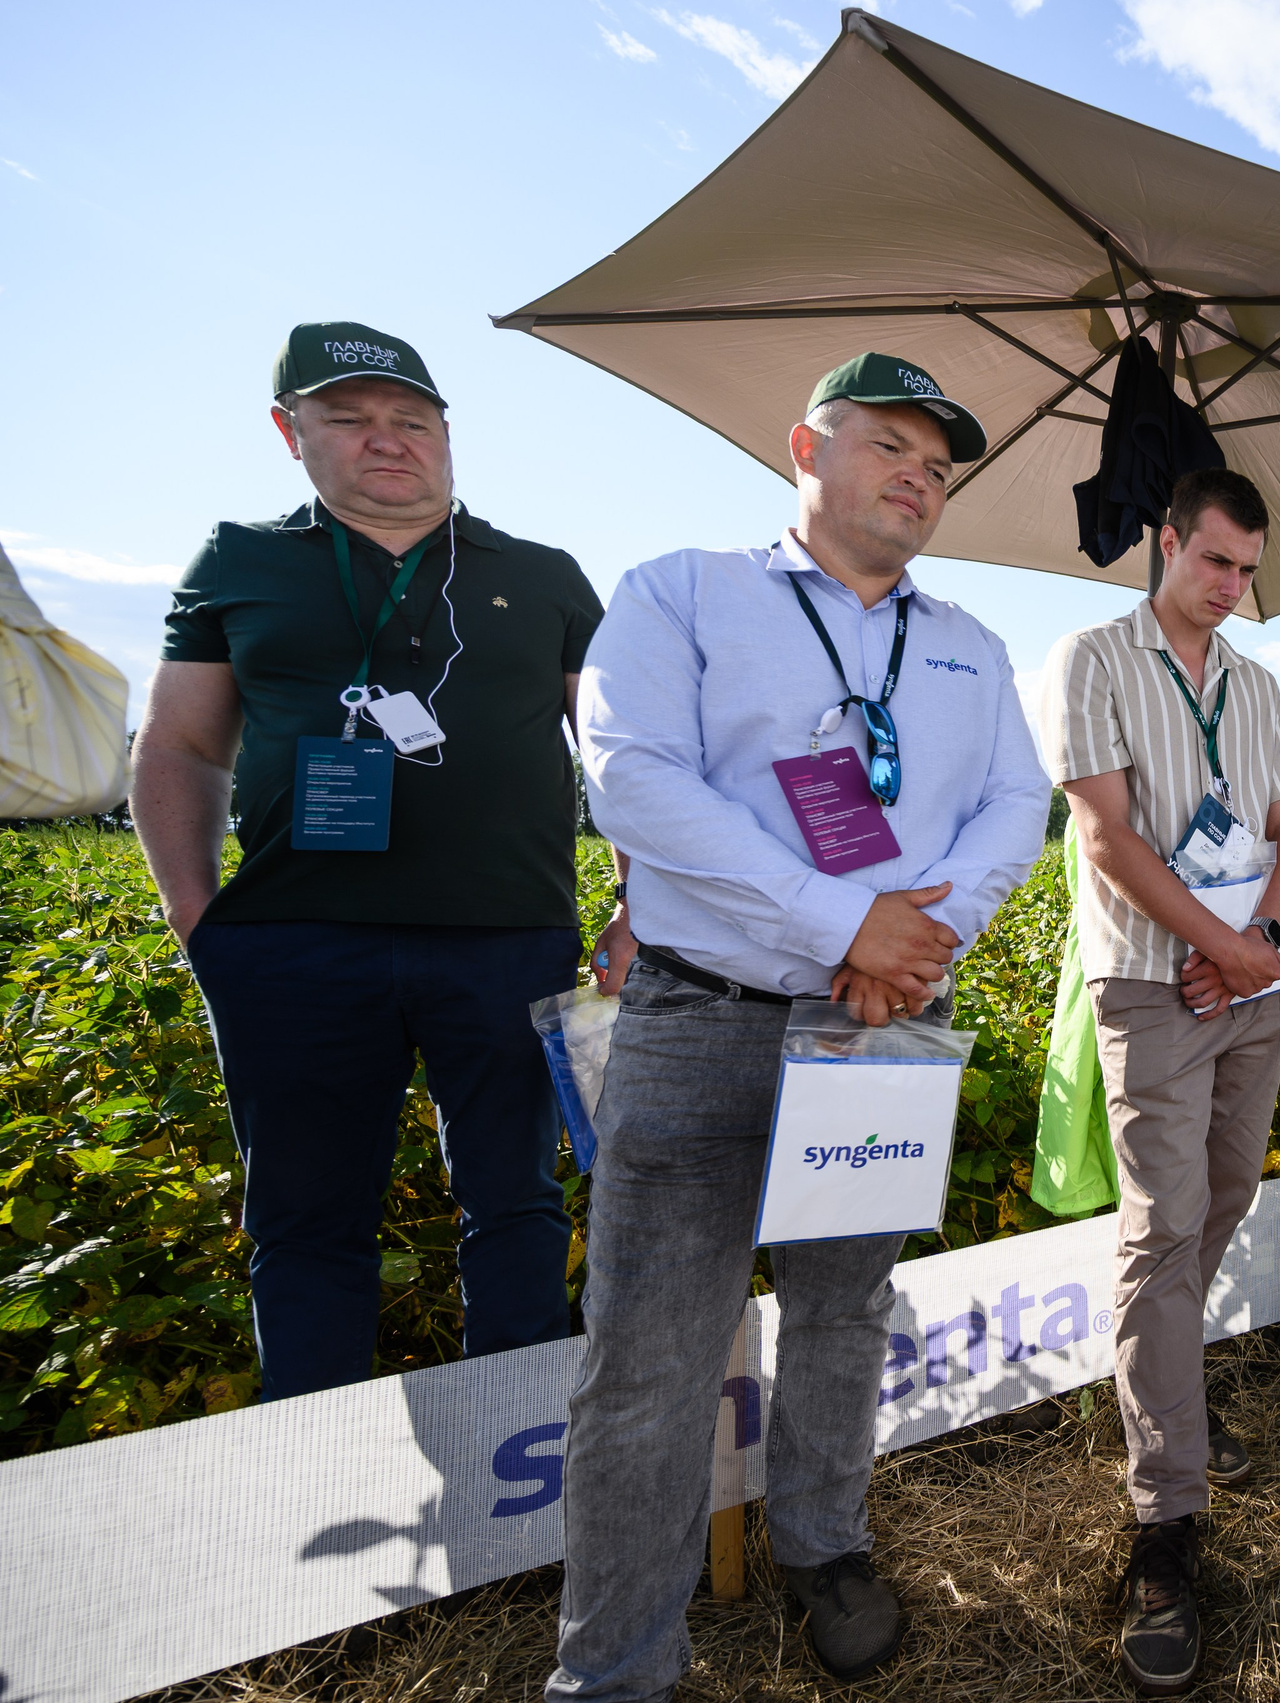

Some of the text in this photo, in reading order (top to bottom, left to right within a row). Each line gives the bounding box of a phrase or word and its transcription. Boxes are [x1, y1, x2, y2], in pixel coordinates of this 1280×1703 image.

[333, 352, 398, 371] ПО СОЕ
[904, 379, 924, 393] ПО
[925, 658, 978, 676] syngenta
[802, 1139, 925, 1171] syngenta
